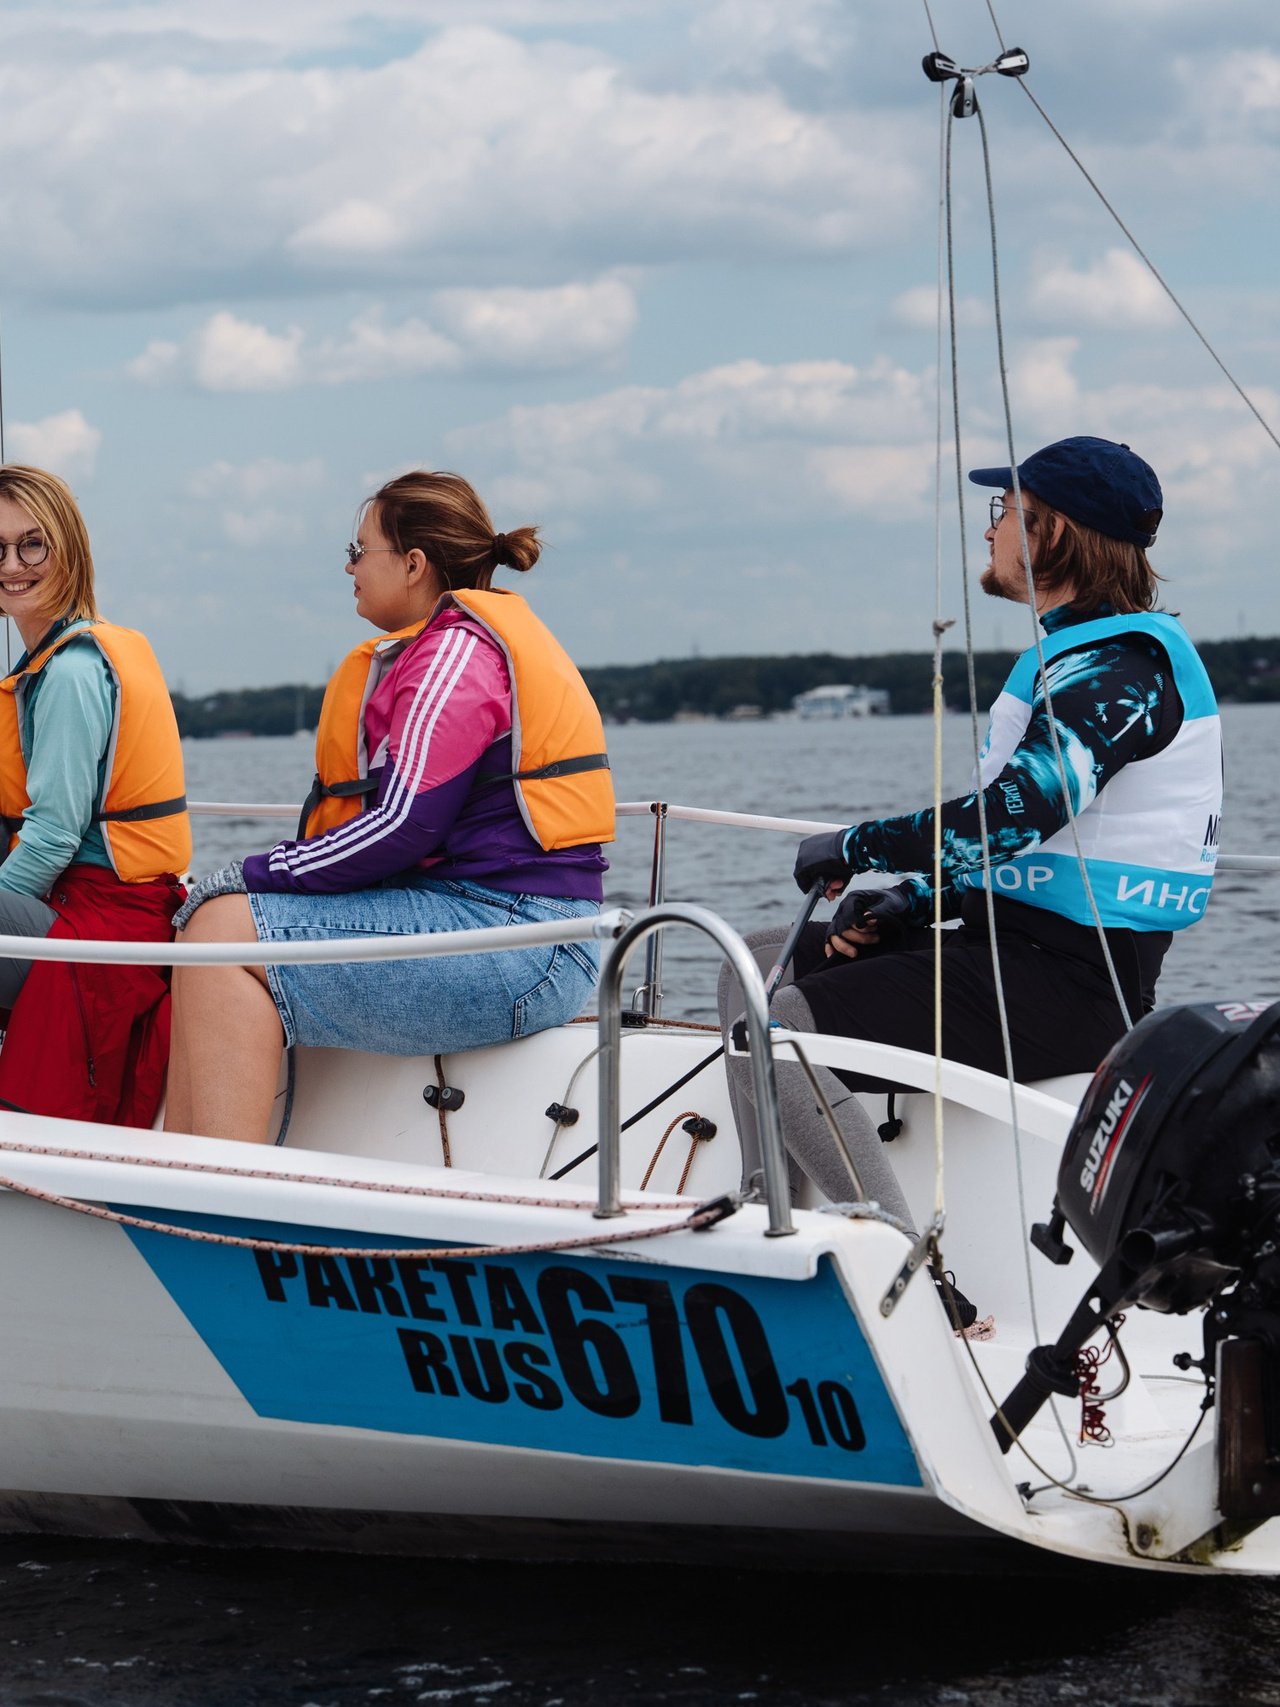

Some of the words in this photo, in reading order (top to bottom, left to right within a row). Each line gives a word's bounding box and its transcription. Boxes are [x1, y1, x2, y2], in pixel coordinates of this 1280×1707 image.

[1080, 1079, 1134, 1193] SUZUKI
[396, 1328, 564, 1411] RUS
[786, 1376, 867, 1452] 10
[537, 1266, 791, 1440] 670
